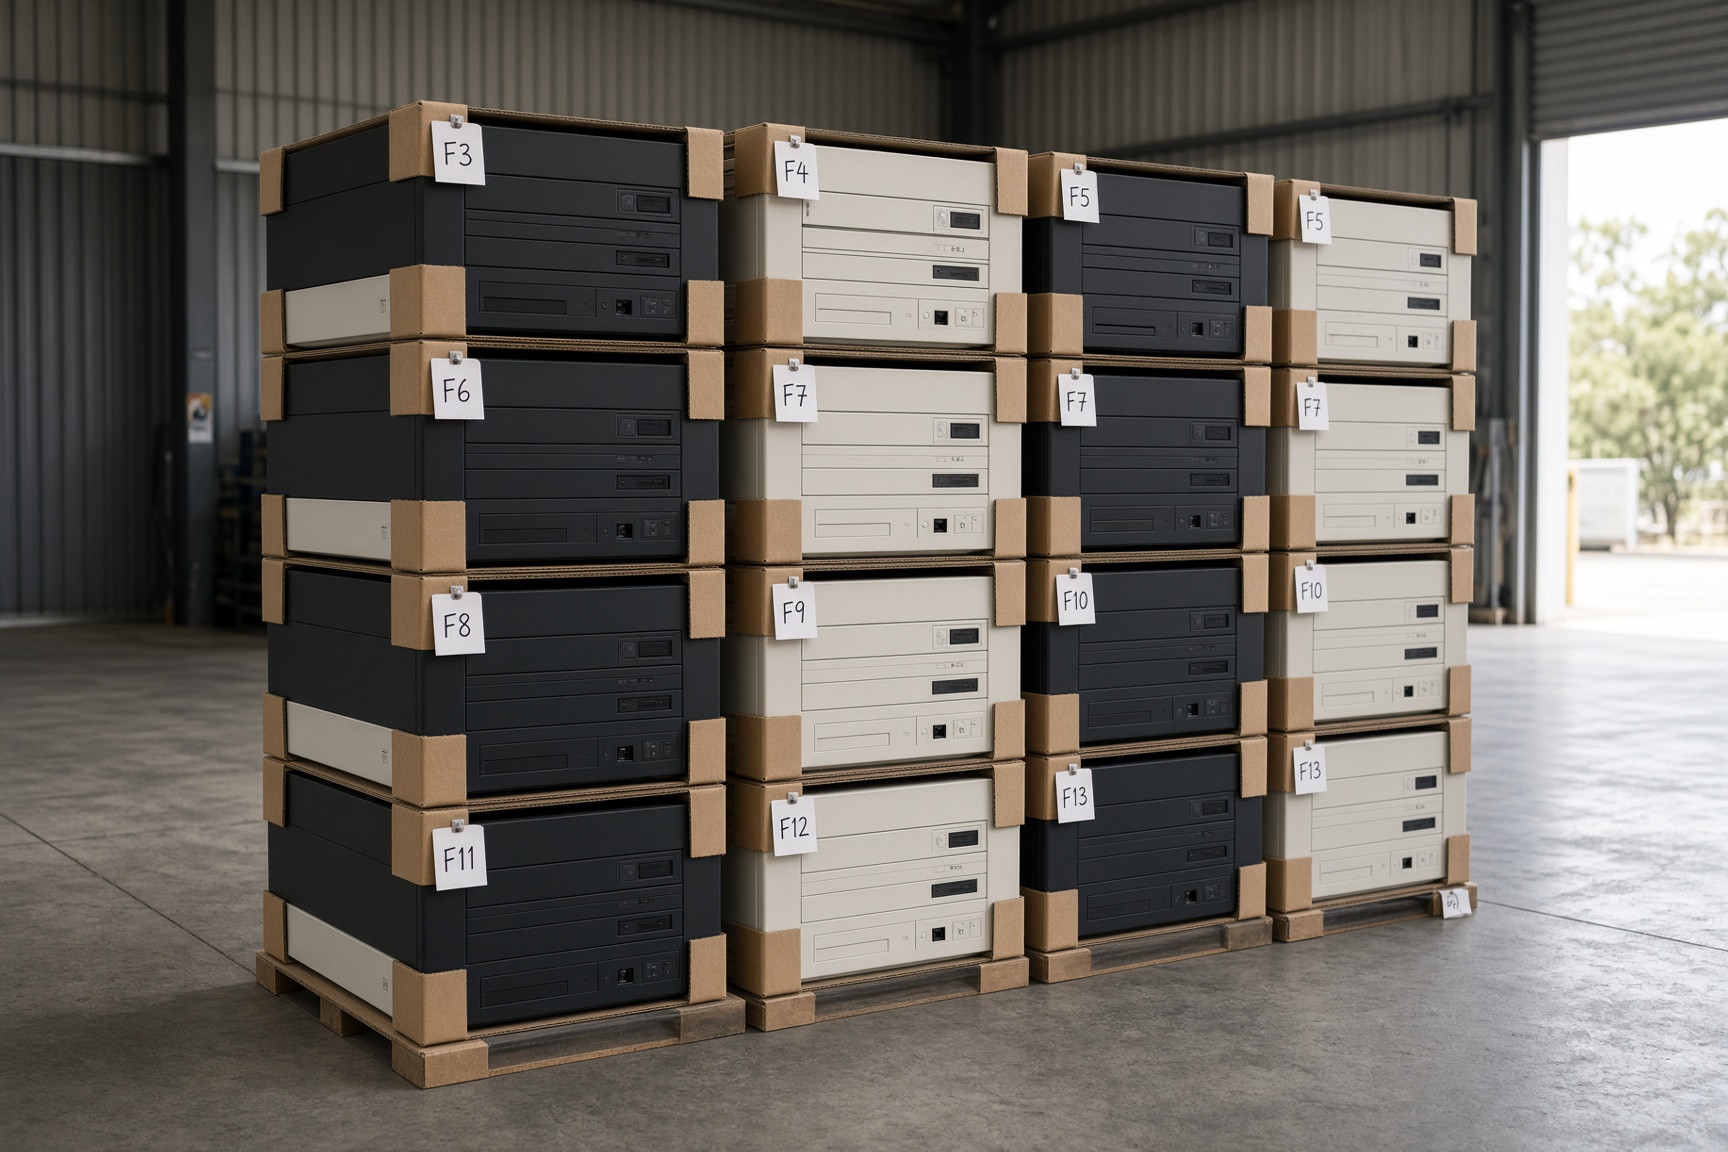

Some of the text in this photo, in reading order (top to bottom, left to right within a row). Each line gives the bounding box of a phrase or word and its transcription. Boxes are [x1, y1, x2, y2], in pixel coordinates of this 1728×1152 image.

[443, 141, 472, 167] F3
[784, 159, 809, 184] F4
[1069, 186, 1090, 208] F5
[1306, 210, 1324, 231] F5
[442, 377, 471, 403] F6
[783, 382, 808, 408] F7
[1066, 390, 1088, 413] F7
[1304, 397, 1321, 418] F7
[1063, 590, 1089, 612] F10
[1301, 581, 1323, 600] F10
[782, 600, 805, 625] F9
[443, 612, 471, 639] F8
[1299, 760, 1322, 782] F13
[1062, 786, 1088, 809] F13
[780, 816, 810, 840] F12
[443, 845, 474, 873] F11
